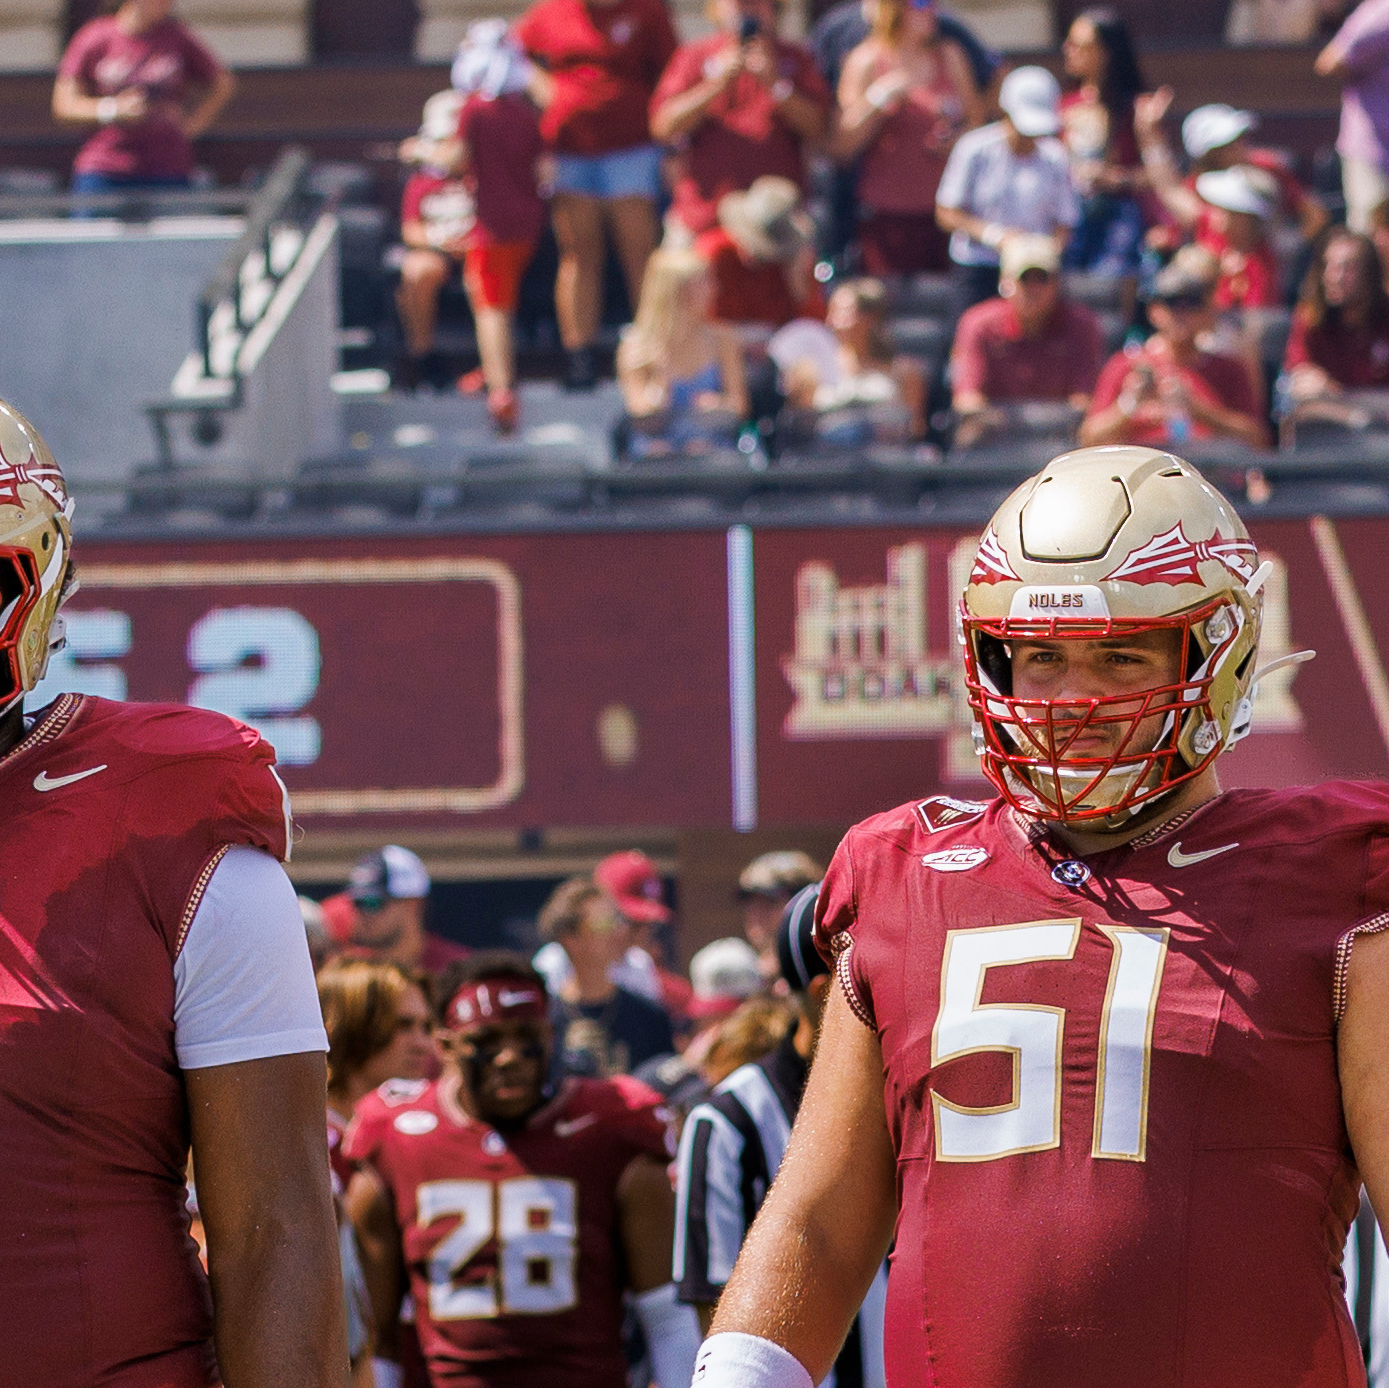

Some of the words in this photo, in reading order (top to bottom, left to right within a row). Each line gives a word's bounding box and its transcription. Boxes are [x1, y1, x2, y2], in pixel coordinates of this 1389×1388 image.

[1028, 593, 1084, 608] NOLES
[188, 606, 323, 766] 2
[930, 850, 981, 863] ACC
[930, 917, 1172, 1163] 51
[416, 1177, 579, 1322] 28
